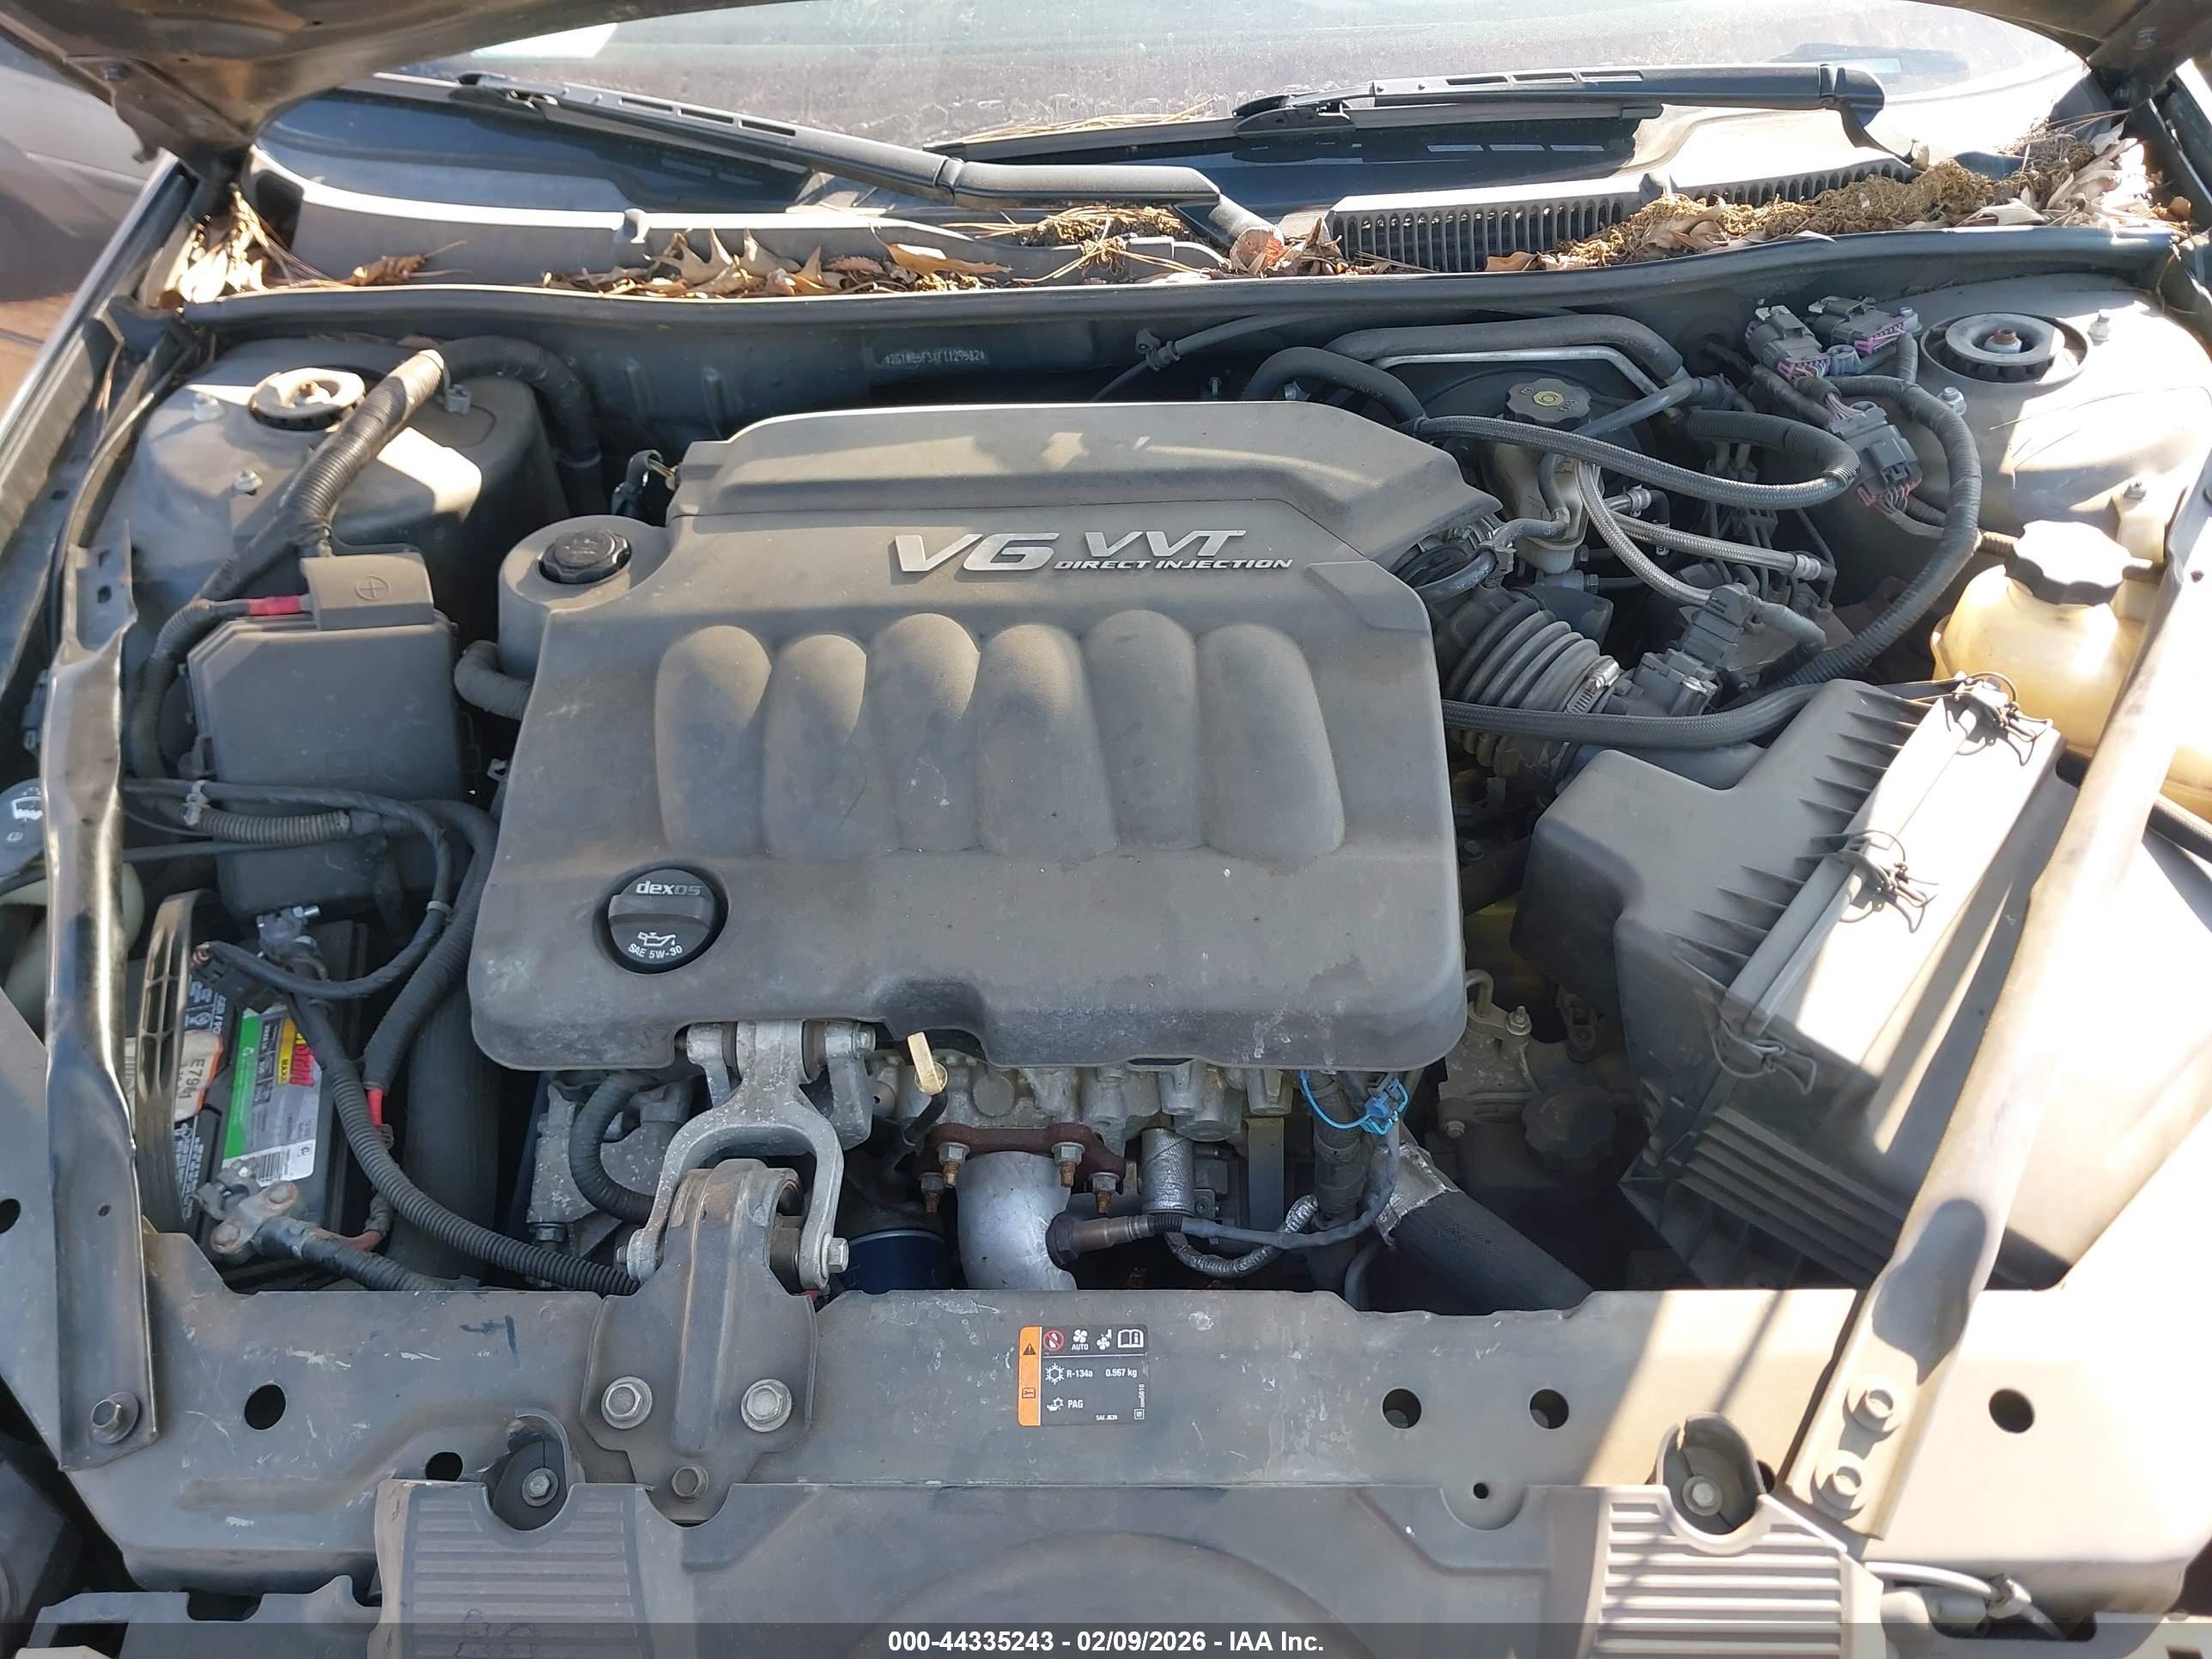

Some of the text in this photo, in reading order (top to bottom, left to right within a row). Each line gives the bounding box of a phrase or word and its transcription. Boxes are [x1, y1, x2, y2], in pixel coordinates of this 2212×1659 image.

[1085, 530, 1247, 557] VVT
[895, 532, 1060, 572] V6
[1054, 558, 1293, 570] DIRECT INJECTION
[635, 880, 703, 896] dexos
[628, 943, 683, 959] SAE 5W-30
[1066, 1370, 1093, 1378] R-134a
[1127, 1369, 1138, 1378] kg
[1067, 1400, 1084, 1408] PAG
